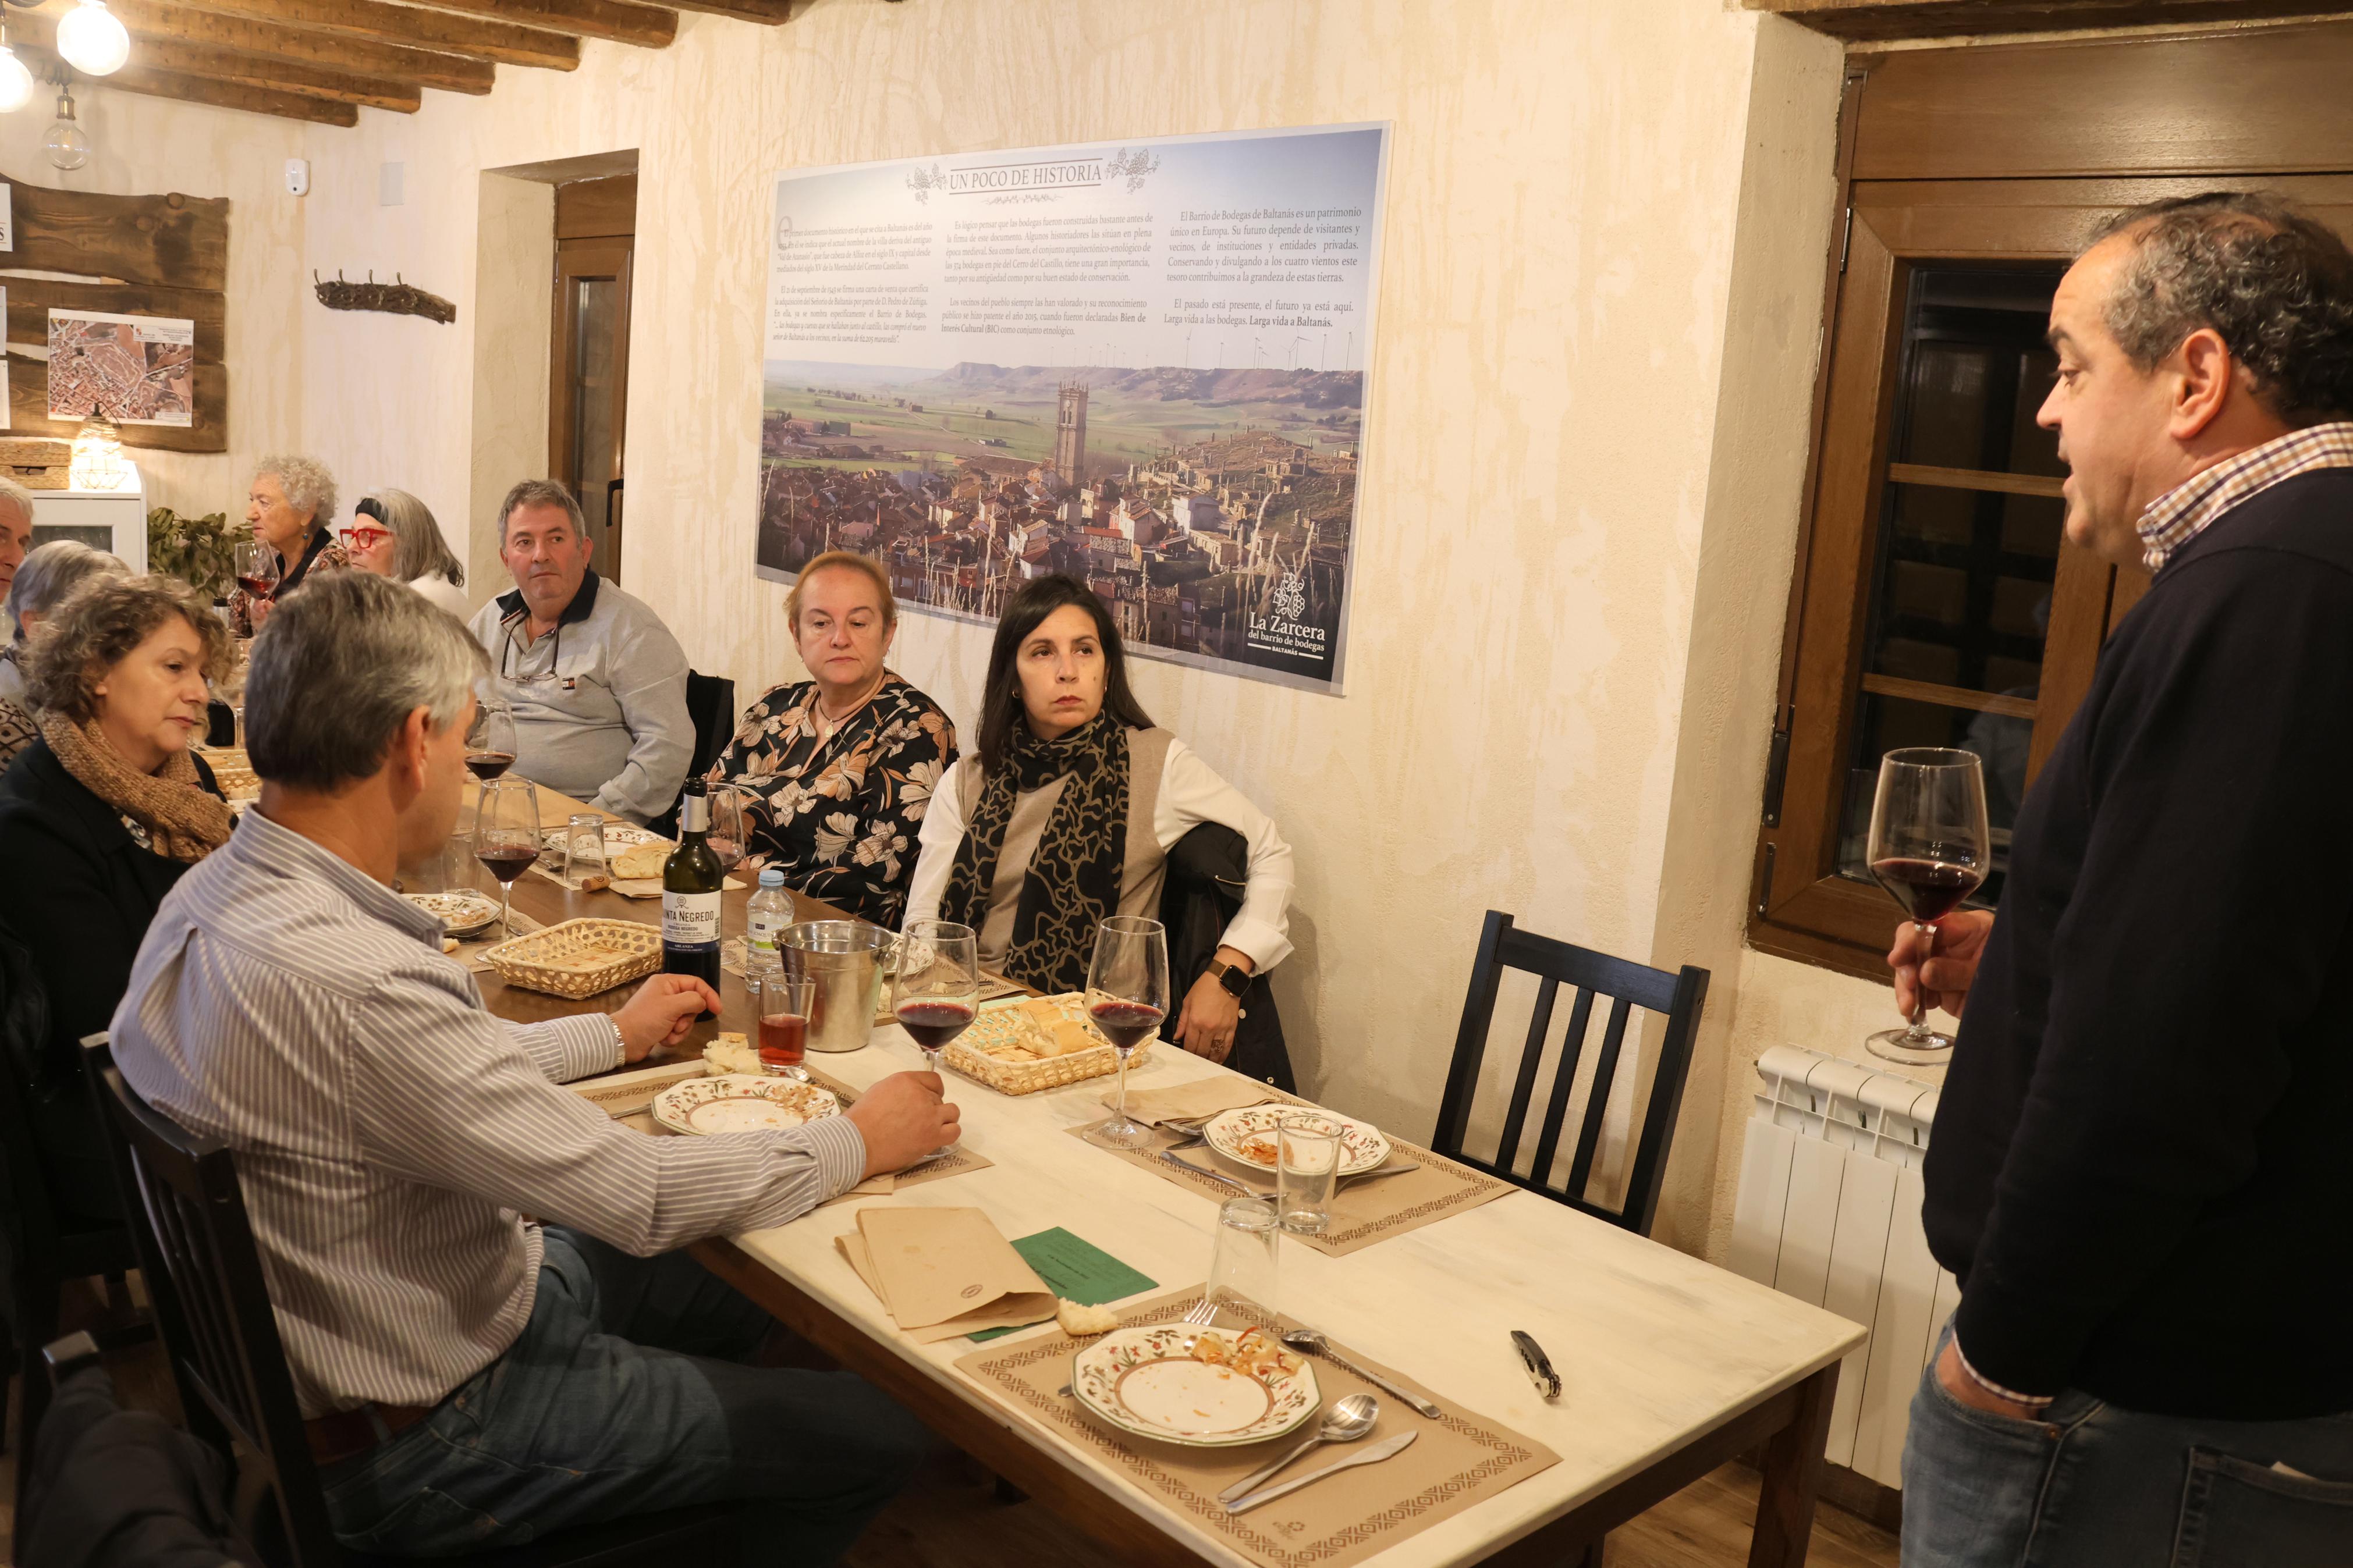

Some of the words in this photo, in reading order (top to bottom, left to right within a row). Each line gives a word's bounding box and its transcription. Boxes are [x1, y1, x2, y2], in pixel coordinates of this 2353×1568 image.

[950, 173, 968, 189] UN
[971, 169, 1007, 188] POCO
[1010, 169, 1029, 185] DE
[1033, 165, 1102, 183] HISTORIA
[954, 221, 961, 229] Es
[978, 222, 998, 231] pensar
[998, 221, 1009, 230] que
[1009, 218, 1018, 227] las
[1018, 218, 1042, 229] bodegas
[1042, 216, 1062, 226] fueron
[1063, 215, 1098, 225] construidas
[1099, 215, 1126, 224] bastante
[1144, 212, 1153, 222] de
[1180, 211, 1188, 221] El
[1188, 211, 1211, 221] Barrio
[1211, 210, 1220, 220] de
[1221, 209, 1251, 222] Bodegas
[1252, 208, 1262, 219] de
[1262, 208, 1294, 219] Baltanás
[1316, 207, 1361, 220] patrimonio
[947, 234, 952, 243] la
[953, 233, 968, 243] firma
[969, 233, 977, 242] de
[1024, 231, 1049, 243] Algunos
[1050, 230, 1089, 240] historiadores
[1091, 228, 1100, 239] las
[1133, 227, 1152, 240] plena
[1170, 227, 1190, 236] único
[1202, 226, 1229, 238] Europa.
[1231, 225, 1241, 235] Su
[1243, 225, 1266, 234] futuro
[1268, 223, 1301, 237] depende
[1303, 223, 1314, 234] de
[1315, 223, 1353, 233] visitantes
[1354, 226, 1360, 236] y
[988, 246, 998, 255] Sea
[1031, 244, 1038, 254] el
[1038, 245, 1065, 256] conjunto
[1065, 243, 1142, 255] arquitectónico-enológico
[1142, 241, 1151, 252] de
[1169, 242, 1196, 253] vecinos,
[1201, 240, 1211, 251] de
[1216, 241, 1262, 251] instituciones
[1268, 243, 1273, 253] y
[1279, 240, 1316, 250] entidades
[1323, 239, 1358, 253] privadas.
[1167, 256, 1213, 266] Conservando
[1215, 259, 1220, 269] y
[1222, 255, 1262, 269] divulgando
[1271, 255, 1282, 266] los
[1311, 256, 1339, 265] vientos
[1341, 258, 1358, 266] este
[1188, 272, 1235, 281] contribuimos
[1243, 271, 1249, 281] la
[1250, 271, 1284, 284] grandeza
[1285, 271, 1296, 282] de
[1317, 272, 1344, 282] tierras.
[950, 297, 959, 306] Los
[960, 298, 980, 306] vecinos
[980, 297, 989, 306] del
[990, 297, 1010, 308] pueblo
[1010, 298, 1034, 309] siempre
[1034, 297, 1044, 307] las
[1044, 297, 1056, 307] han
[1056, 297, 1083, 307] valorado
[1084, 300, 1088, 310] y
[1098, 298, 1147, 308] reconocimiento
[1174, 298, 1181, 308] El
[1184, 299, 1209, 311] pasado
[1212, 300, 1226, 309] está
[1229, 302, 1262, 312] presente,
[1265, 300, 1272, 310] el
[1275, 300, 1299, 310] futuro
[1302, 304, 1311, 313] ya
[1314, 301, 1330, 311] está
[1333, 301, 1353, 314] aquí.
[942, 310, 962, 321] público
[970, 310, 982, 319] hizo
[983, 313, 1004, 322] patente
[1005, 310, 1011, 320] el
[1012, 311, 1023, 320] año
[1039, 311, 1062, 321] cuando
[1063, 311, 1083, 321] fueron
[1085, 312, 1118, 322] declaradas
[1120, 312, 1135, 322] Bien
[1137, 312, 1146, 322] de
[1164, 314, 1183, 326] Larga
[1184, 314, 1198, 323] vida
[1206, 314, 1215, 323] las
[1217, 314, 1247, 327] bodegas.
[1249, 315, 1270, 328] Larga
[1272, 315, 1289, 326] vida
[1296, 316, 1333, 327] Baltanás.
[941, 323, 960, 332] Interés
[960, 323, 984, 333] Cultural
[984, 324, 1000, 334] (BIC)
[1016, 325, 1042, 335] conjunto
[1042, 326, 1075, 337] etnológico.
[1249, 612, 1266, 631] La
[1270, 616, 1325, 641] Zarcera
[1248, 630, 1259, 639] del
[1261, 631, 1283, 643] barrio
[1284, 635, 1294, 645] de
[1295, 638, 1325, 652] bodegas
[1272, 646, 1298, 656] BALTANÁS
[679, 911, 714, 922] NEGREDO
